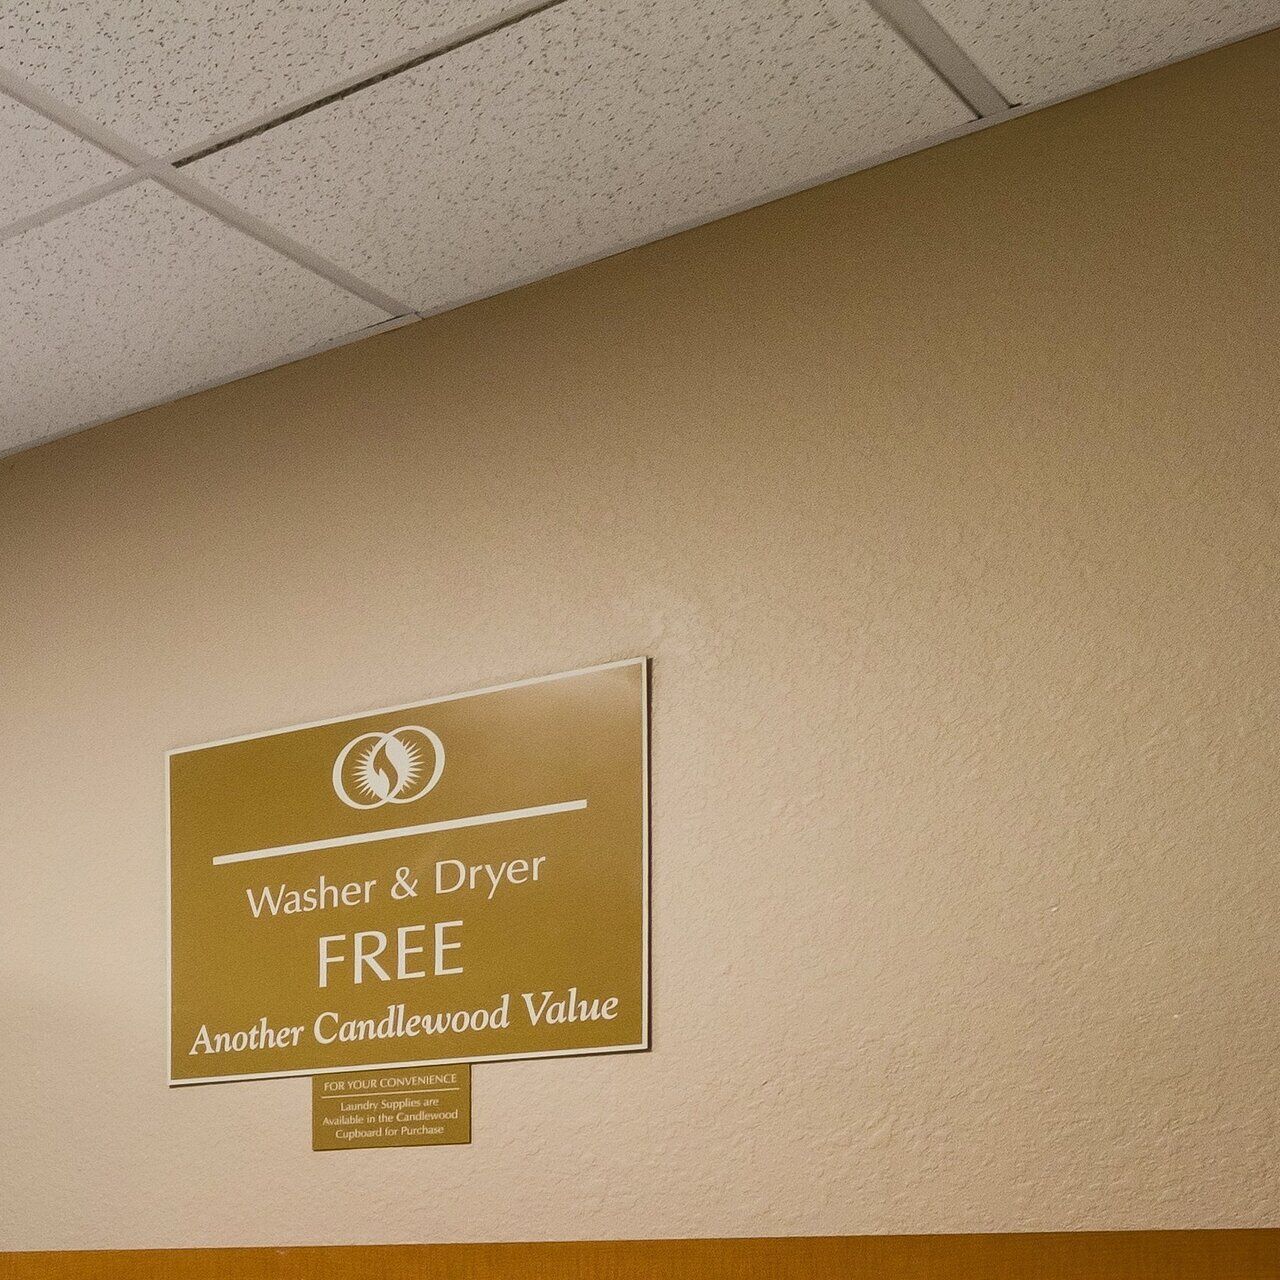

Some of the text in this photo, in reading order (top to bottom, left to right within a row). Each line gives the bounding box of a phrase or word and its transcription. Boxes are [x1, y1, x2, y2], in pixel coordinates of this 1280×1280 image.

[245, 856, 546, 918] Washer & Dryer
[318, 920, 464, 988] FREE
[188, 987, 619, 1056] Another Candlewood Value
[324, 1073, 457, 1091] FOR YOUR CONVENIENCE
[340, 1098, 440, 1112] Laundry Supplies are
[322, 1108, 458, 1126] Available in the Candlewood
[335, 1124, 444, 1141] Cupboard for Purchase
